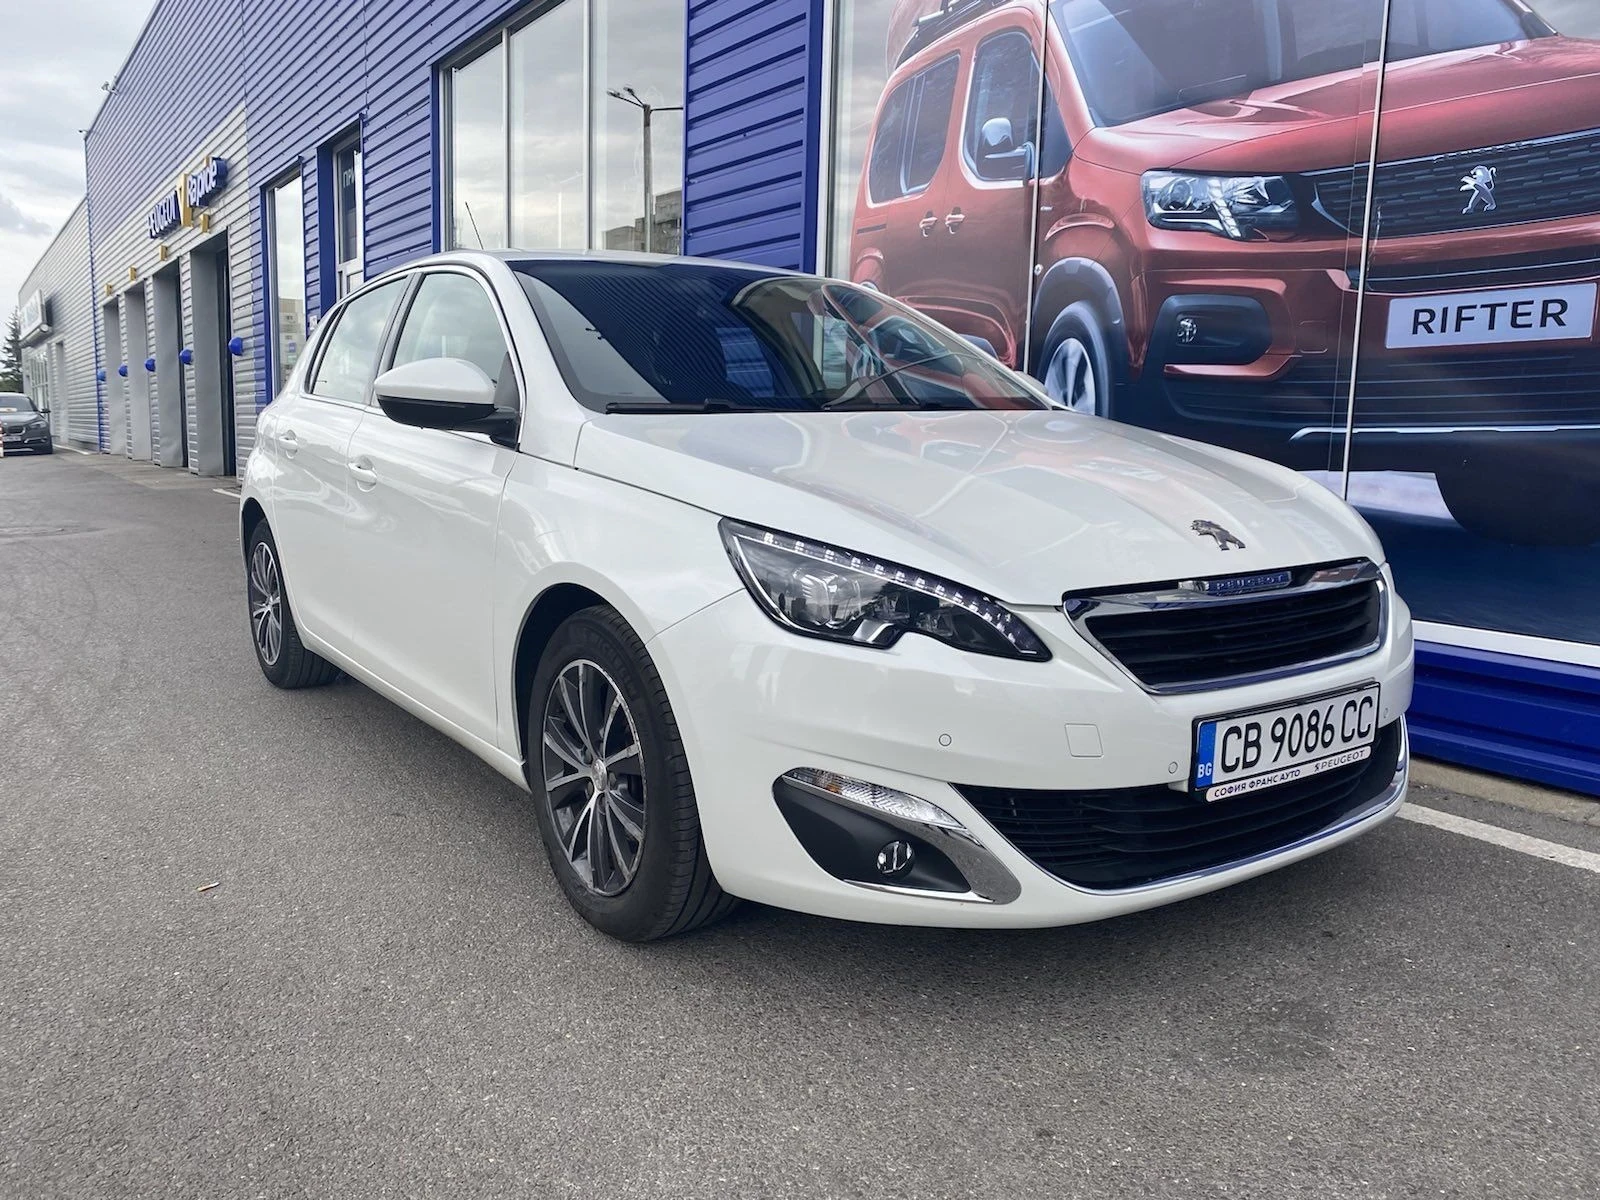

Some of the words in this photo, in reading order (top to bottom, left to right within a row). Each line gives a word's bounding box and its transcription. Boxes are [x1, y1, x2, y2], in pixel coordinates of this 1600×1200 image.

[187, 157, 218, 208] Rapide
[1412, 299, 1569, 335] RIFTER
[1221, 722, 1262, 773] CB
[1271, 705, 1334, 763] 9086
[1341, 696, 1373, 743] CC
[1198, 763, 1213, 779] BG
[1322, 749, 1365, 769] PEUGEOT
[1214, 783, 1246, 798] СОФИЯ
[1248, 775, 1279, 789] ФРАНС
[1279, 769, 1301, 782] АУТО
